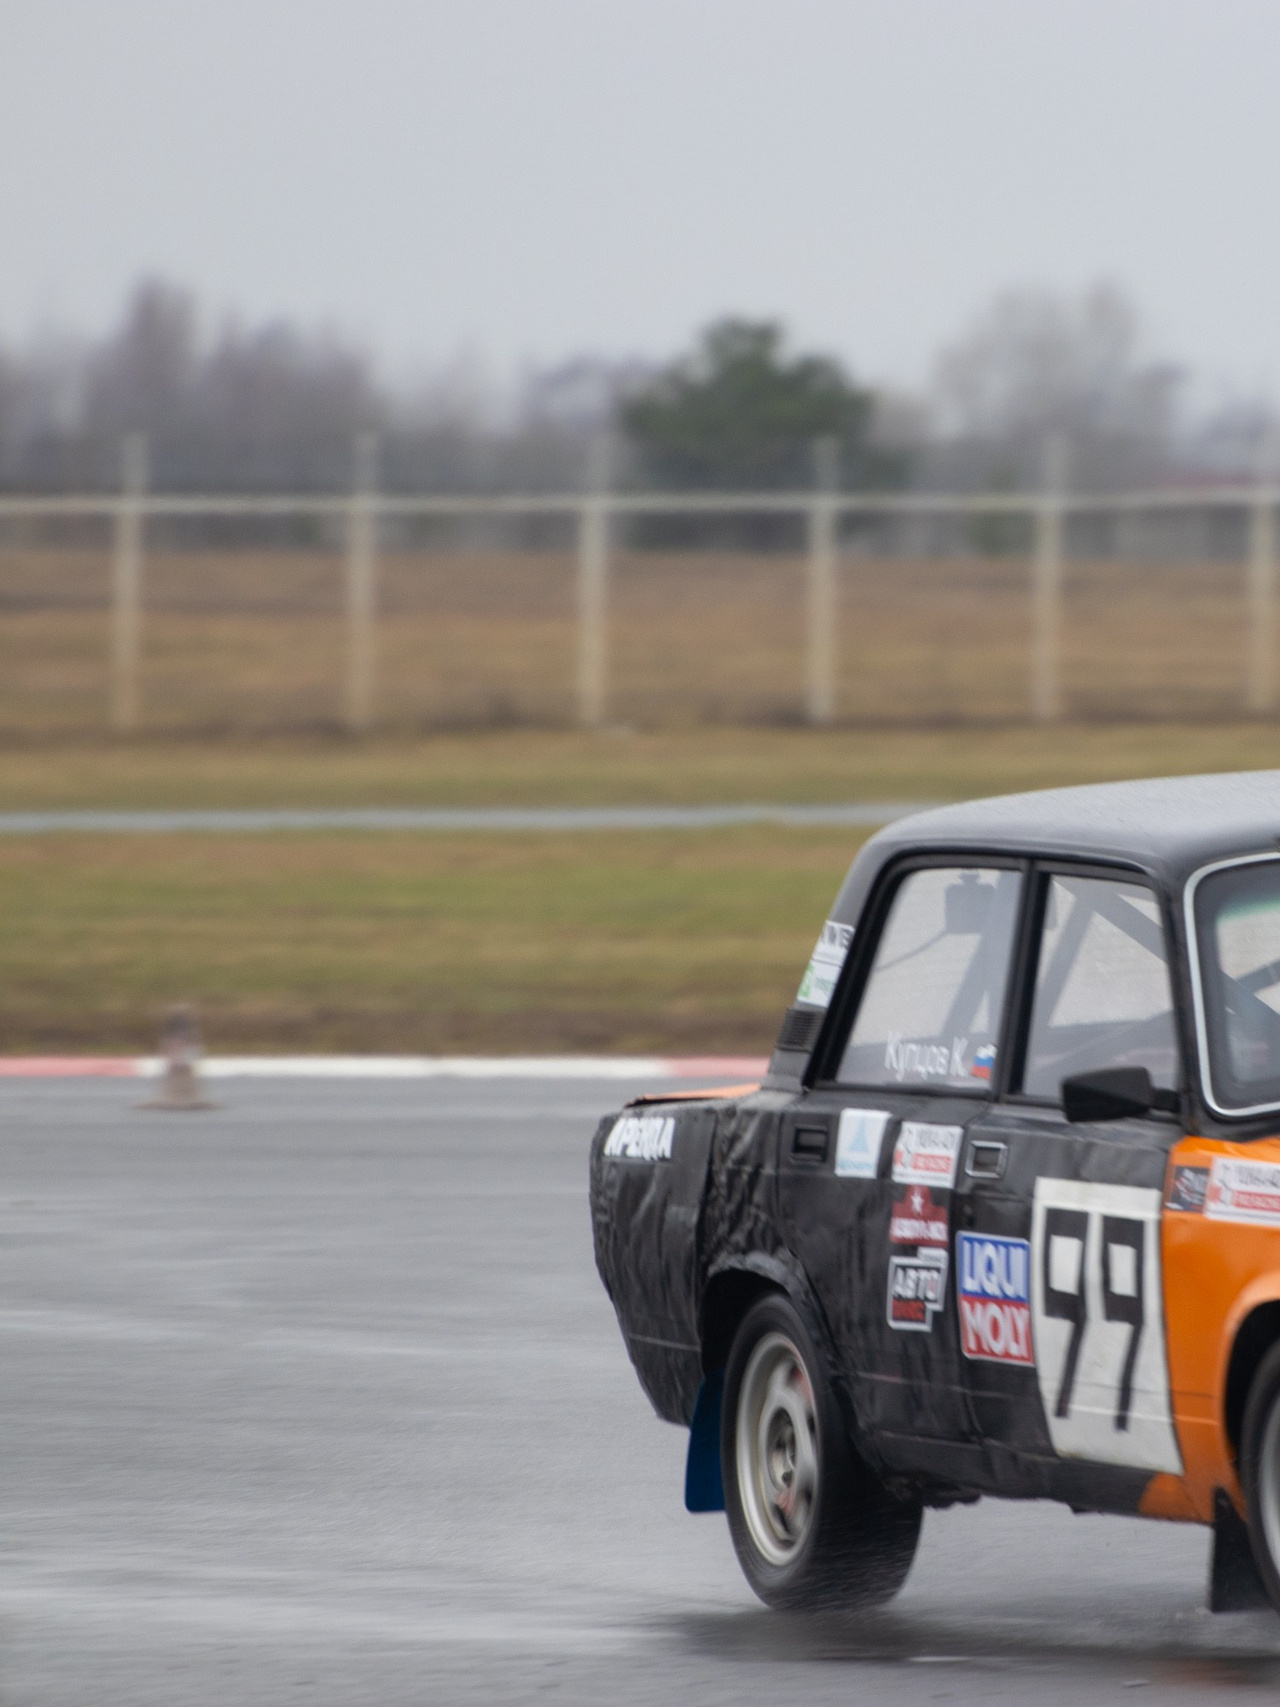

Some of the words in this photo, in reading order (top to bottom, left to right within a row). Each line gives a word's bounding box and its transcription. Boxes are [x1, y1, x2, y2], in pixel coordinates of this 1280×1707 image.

[962, 1240, 1027, 1300] LIQUI
[962, 1300, 1030, 1358] MOLY
[1044, 1207, 1145, 1431] 99
